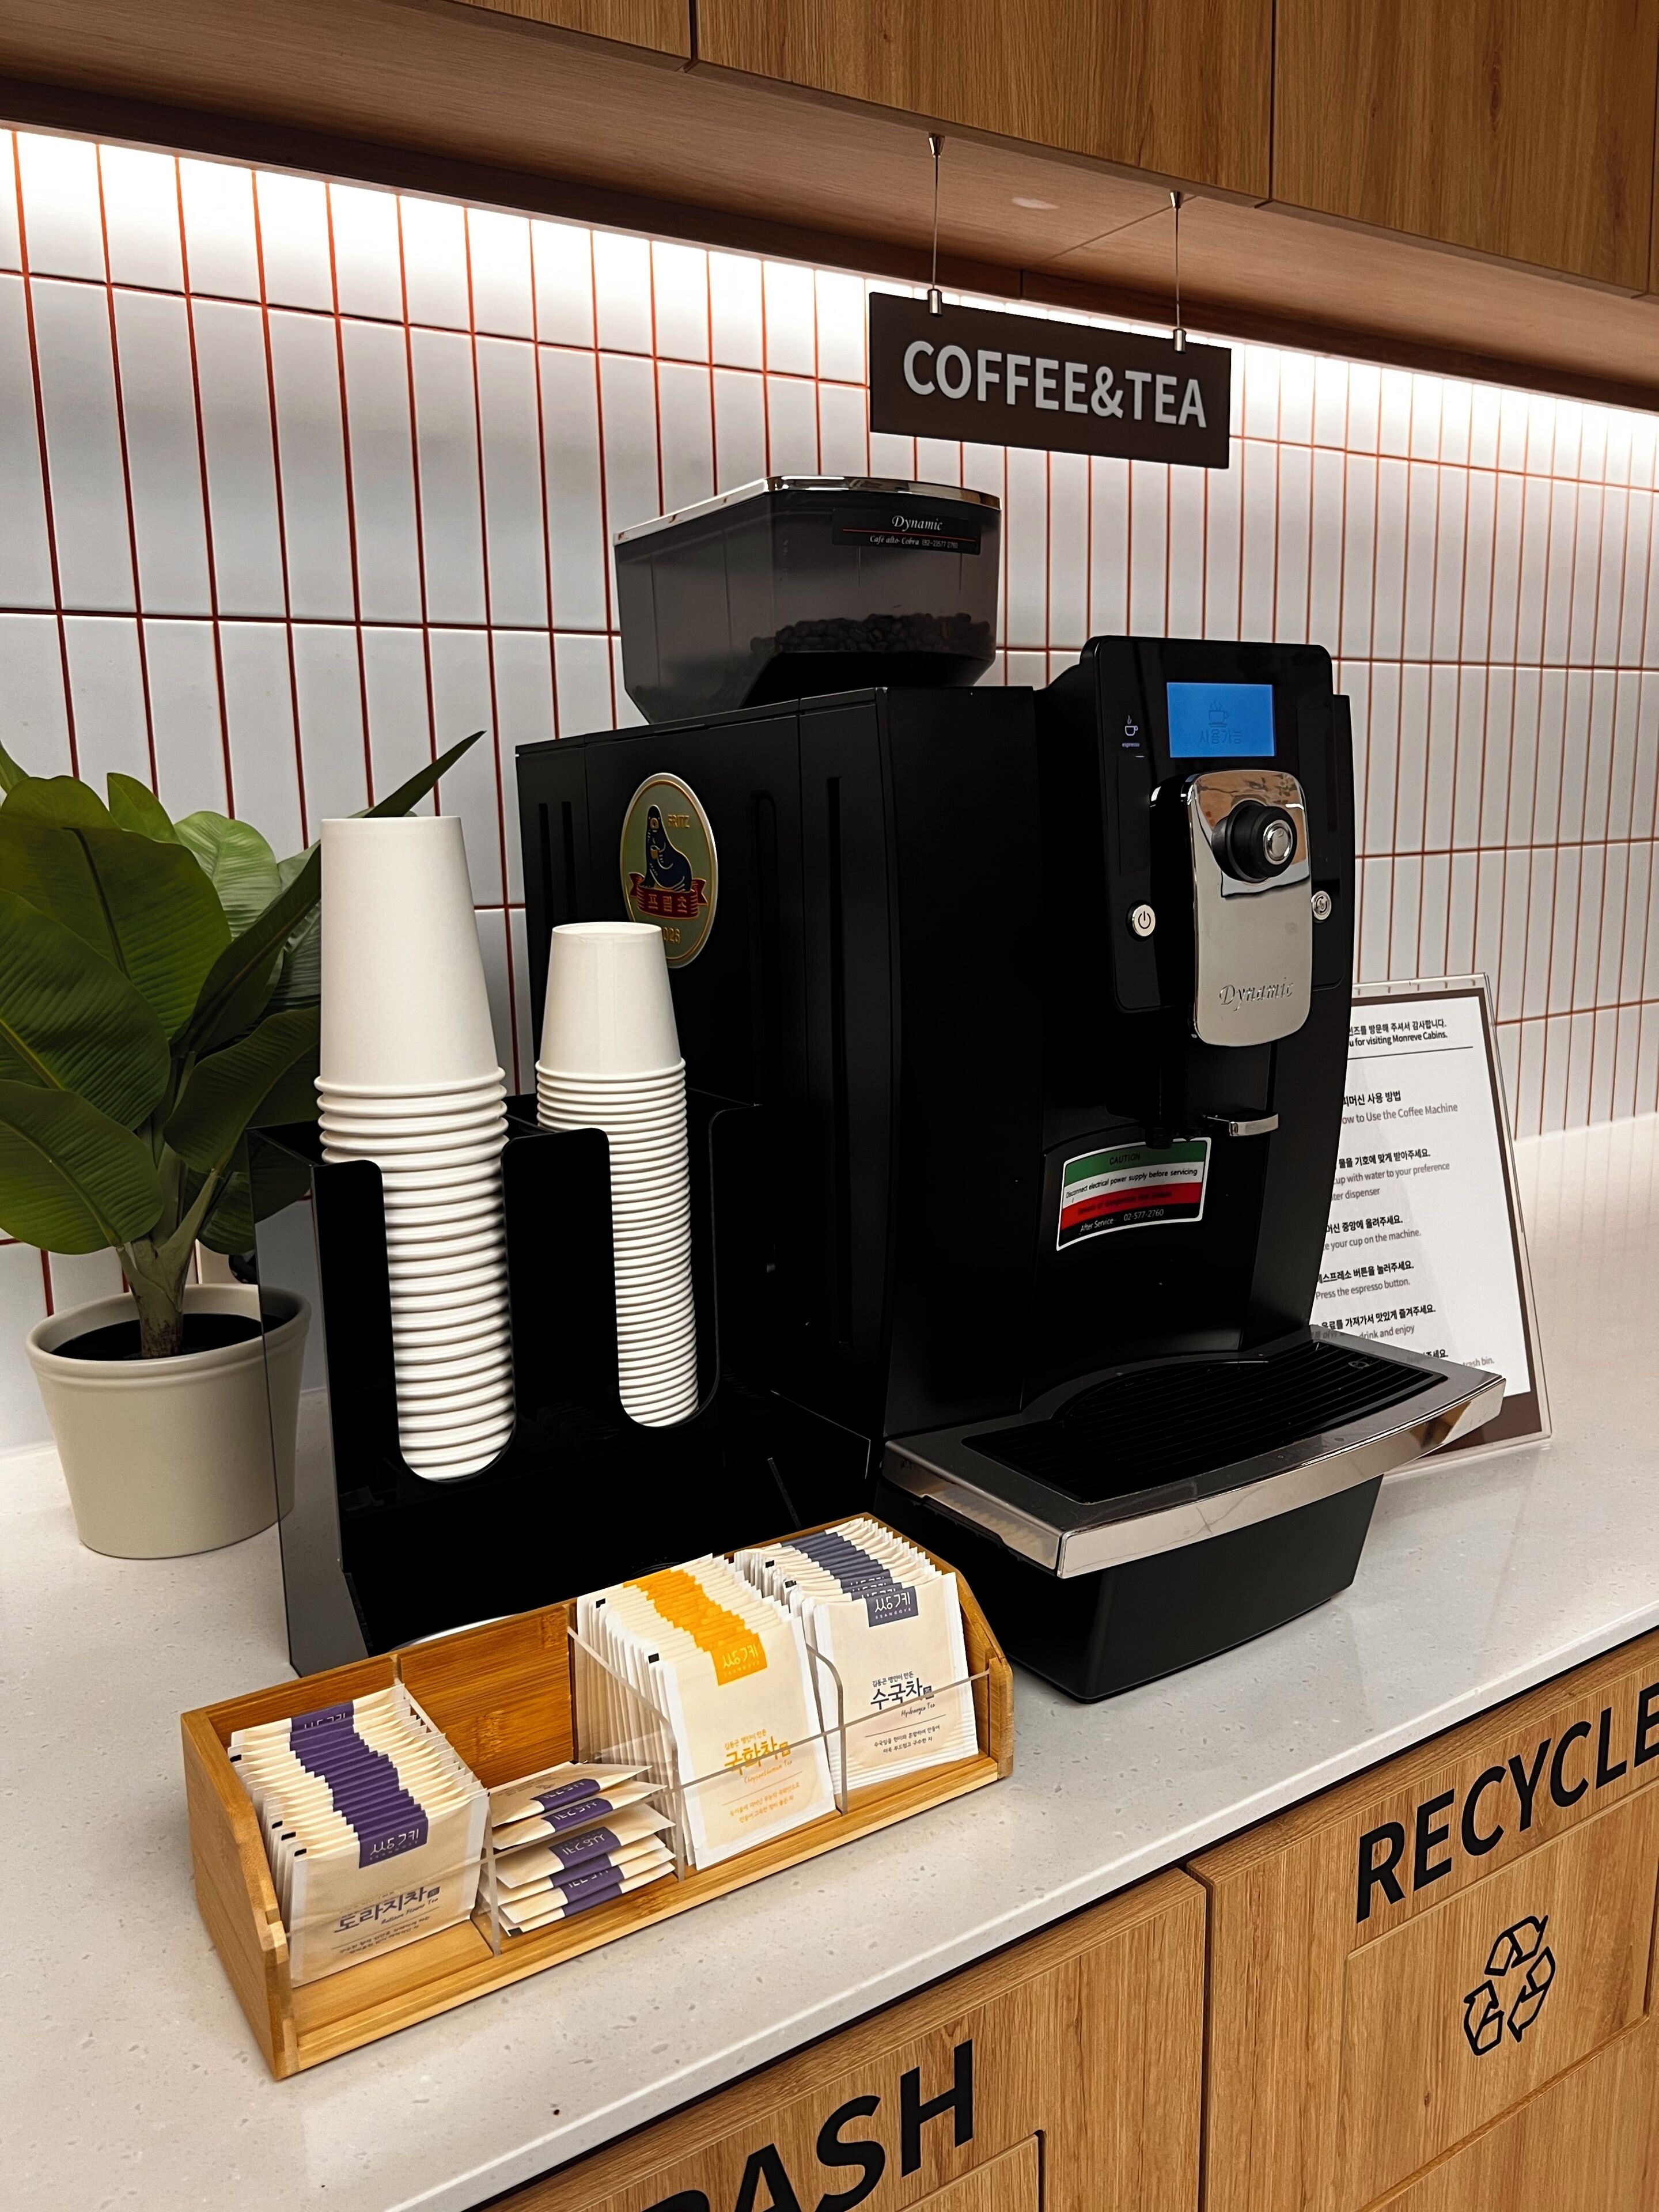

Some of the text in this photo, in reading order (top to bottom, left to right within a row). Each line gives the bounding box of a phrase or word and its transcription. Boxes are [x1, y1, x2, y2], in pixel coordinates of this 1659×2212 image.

[903, 340, 1207, 428] COFFEE&TEA
[892, 515, 942, 532] Dynamic
[668, 815, 690, 830] FRITZ
[1219, 977, 1294, 1012] Dynamic
[1369, 1023, 1389, 1035] 방문해
[1391, 1022, 1410, 1033] 주셔서
[1412, 1018, 1446, 1031] 감사합니다.
[1355, 1037, 1365, 1046] for
[1366, 1036, 1392, 1046] visiting
[1392, 1034, 1422, 1043] Monreve
[1423, 1031, 1448, 1040] Cabins.
[1368, 1092, 1383, 1104] 사용
[1385, 1090, 1402, 1103] 방법
[1342, 1103, 1458, 1124] ow to Use the Coffee Machine
[1109, 1153, 1141, 1165] CAUTION
[1338, 1148, 1431, 1169] 물을 기호에 맞게 받아주세요.
[1347, 1173, 1363, 1183] with
[1364, 1171, 1385, 1181] water
[1386, 1169, 1394, 1178] to
[1395, 1167, 1411, 1179] your
[1412, 1162, 1450, 1176] preference
[1066, 1168, 1198, 1199] Disconnect electrical power supply before servicing
[1332, 1187, 1380, 1201] ter dispenser
[1080, 1208, 1164, 1233] After Service 02-577-2760
[1342, 1220, 1363, 1232] 중앙에
[1365, 1215, 1403, 1229] 올려주세요.
[1331, 1240, 1348, 1252] your
[1349, 1238, 1363, 1247] cup
[1364, 1236, 1374, 1244] on
[1374, 1233, 1388, 1243] the
[1388, 1229, 1422, 1240] machine.
[1354, 1266, 1375, 1278] 버튼을
[1377, 1260, 1415, 1275] 눌러주세요.
[1315, 1278, 1411, 1300] Press the espresso button.
[1345, 1315, 1374, 1327] 가져가서
[1376, 1309, 1397, 1323] 맛있게
[1399, 1304, 1436, 1319] 즐겨주세요.
[1359, 1324, 1415, 1340] drink and enjoy
[1481, 1356, 1495, 1365] bin.
[870, 1677, 923, 1710] 수국차
[927, 1702, 935, 1710] Tea
[1357, 1682, 1659, 1924] RECYCLE
[334, 1887, 427, 1933] 도라지차
[641, 2039, 974, 2212] ASH
